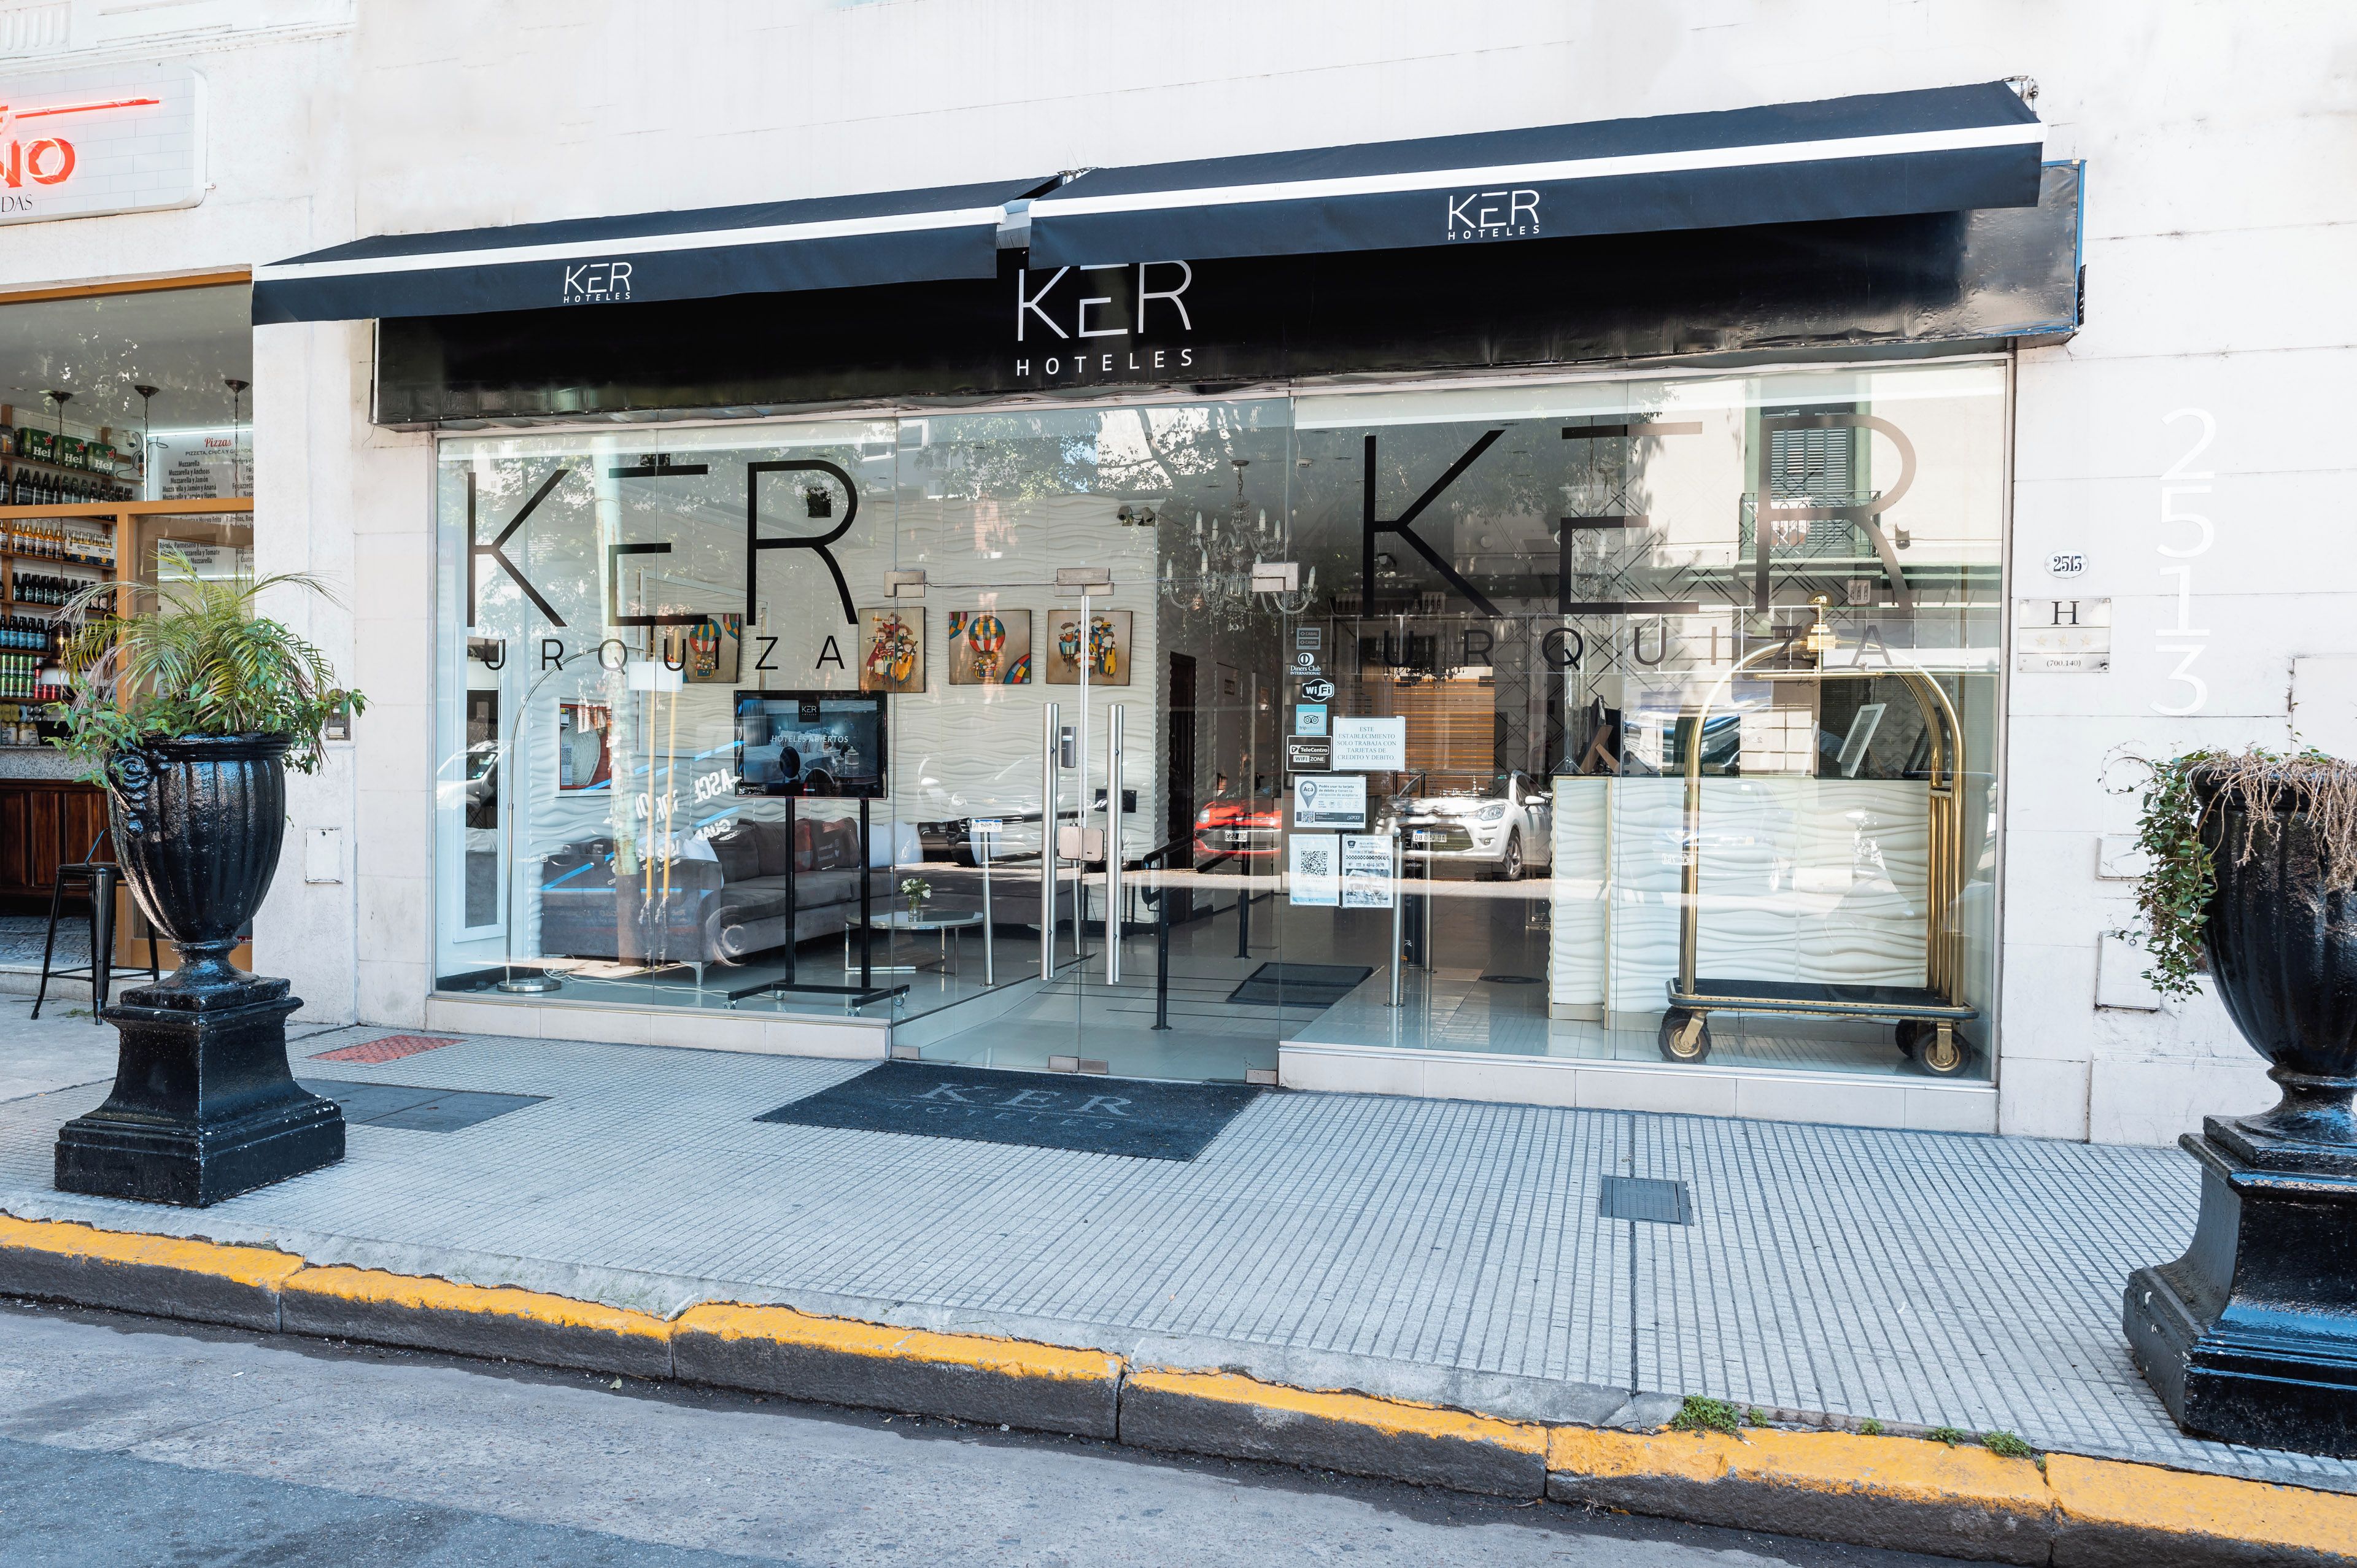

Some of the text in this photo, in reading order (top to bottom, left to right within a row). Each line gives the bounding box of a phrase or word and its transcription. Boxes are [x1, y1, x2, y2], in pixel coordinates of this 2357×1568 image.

[1448, 190, 1540, 230] KER
[1448, 225, 1540, 241] HOTELES
[564, 262, 632, 295] KER
[563, 292, 630, 304] HOTELES
[1018, 260, 1192, 341] KER
[1016, 349, 1192, 376] HOTELES
[204, 437, 233, 447] Pizzas
[1363, 413, 1918, 615] KER
[466, 460, 859, 628] KER
[2148, 407, 2217, 716] 2513
[2053, 555, 2082, 572] 2513
[2051, 601, 2080, 625] H
[484, 635, 845, 676] URQUIZA
[1382, 624, 1894, 671] URQUIZA
[910, 1082, 1132, 1117] KER
